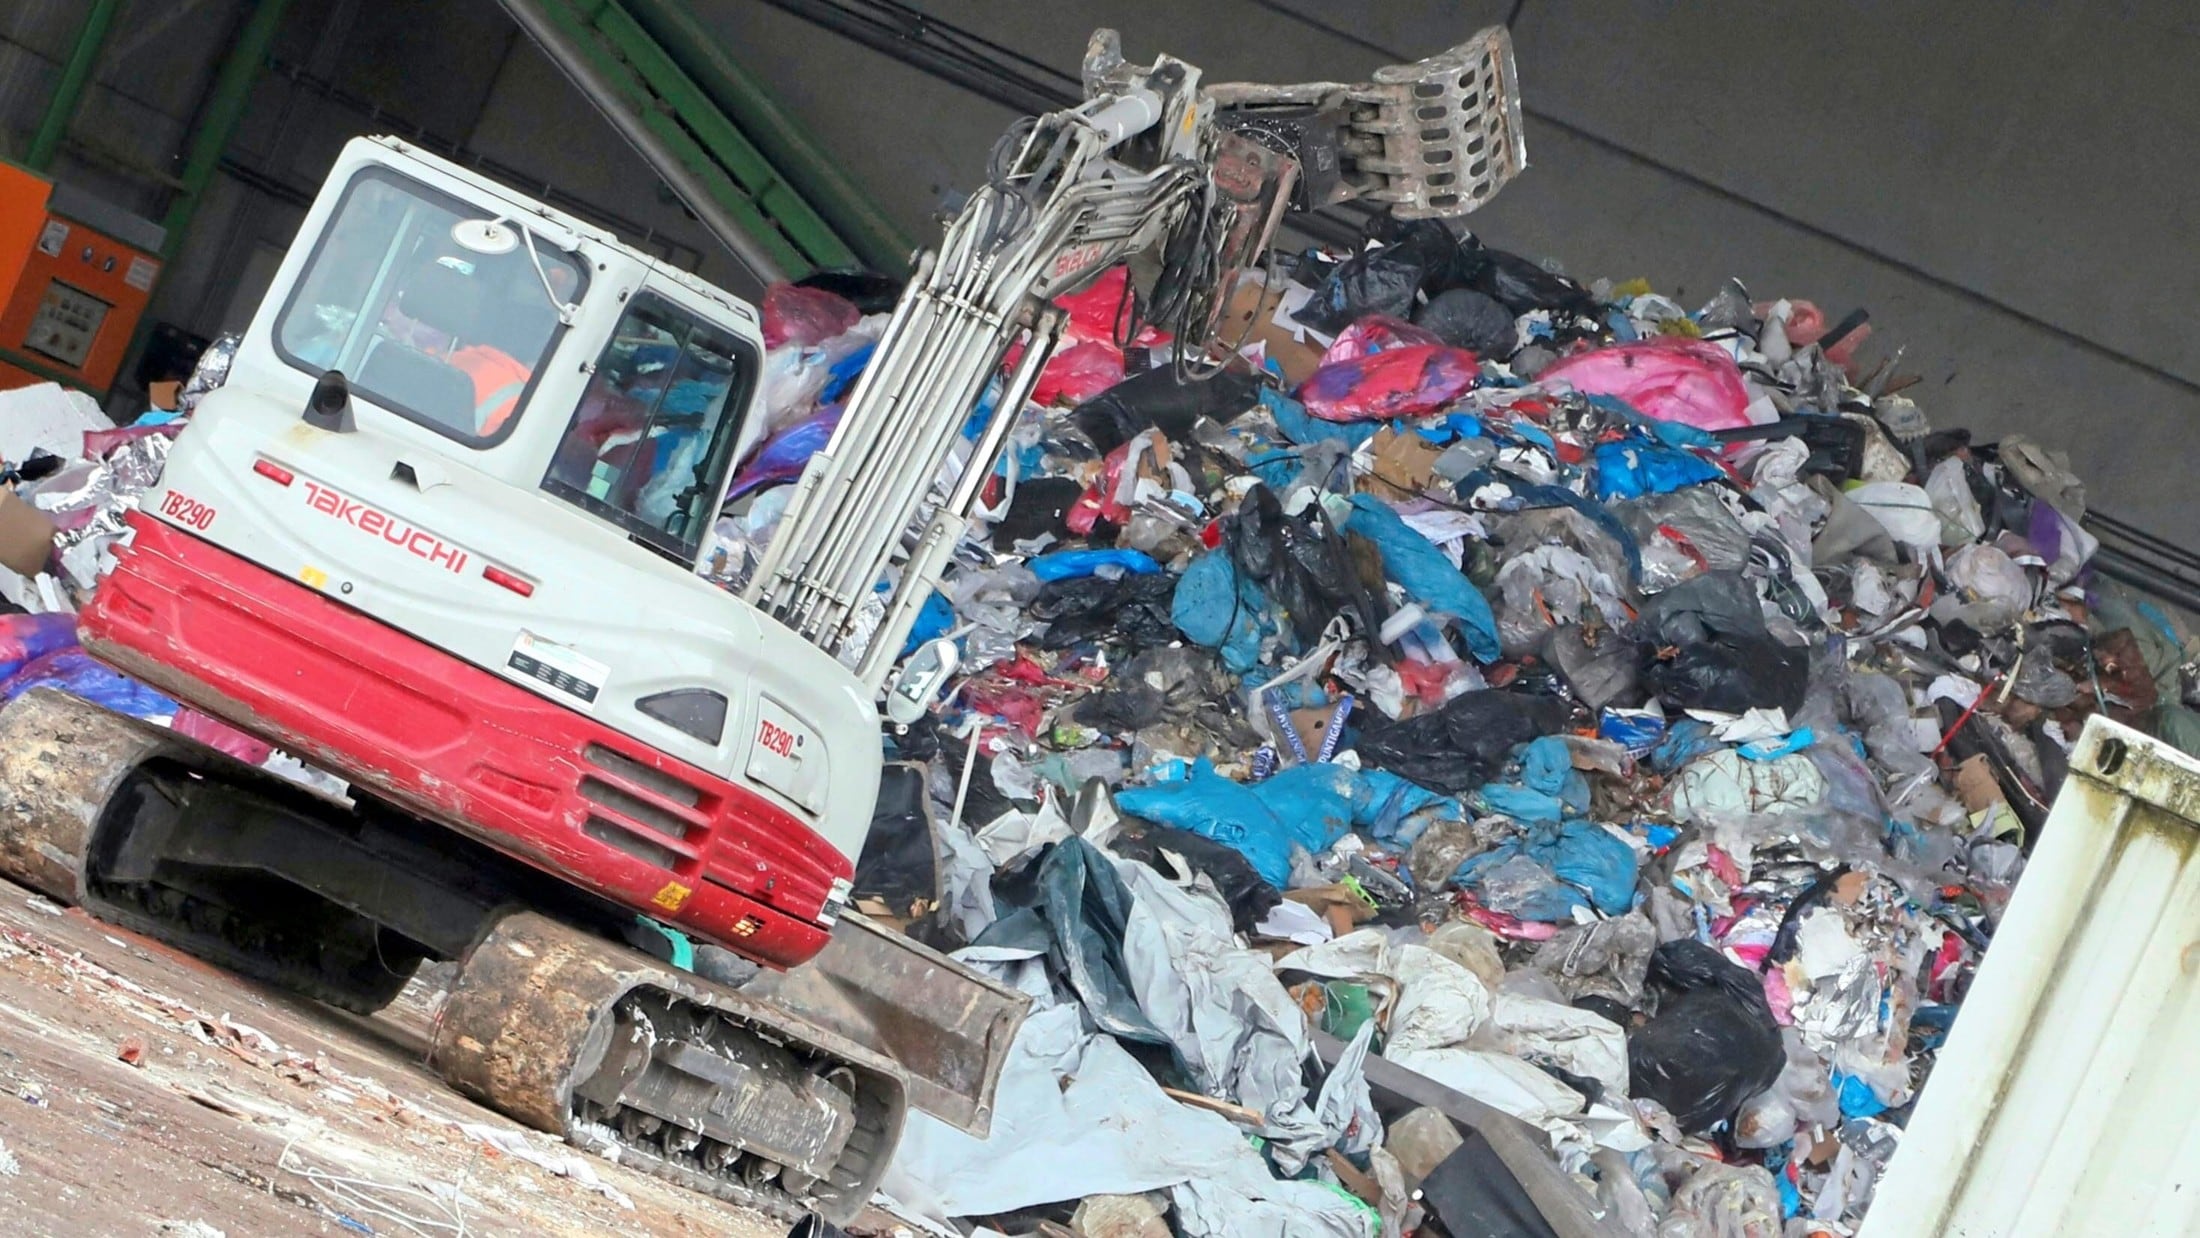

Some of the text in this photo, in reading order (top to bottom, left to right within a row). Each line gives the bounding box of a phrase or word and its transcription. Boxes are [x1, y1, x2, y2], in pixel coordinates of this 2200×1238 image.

[159, 490, 216, 531] TB290
[304, 482, 468, 573] TAKEUCHI
[758, 720, 794, 757] TB290
